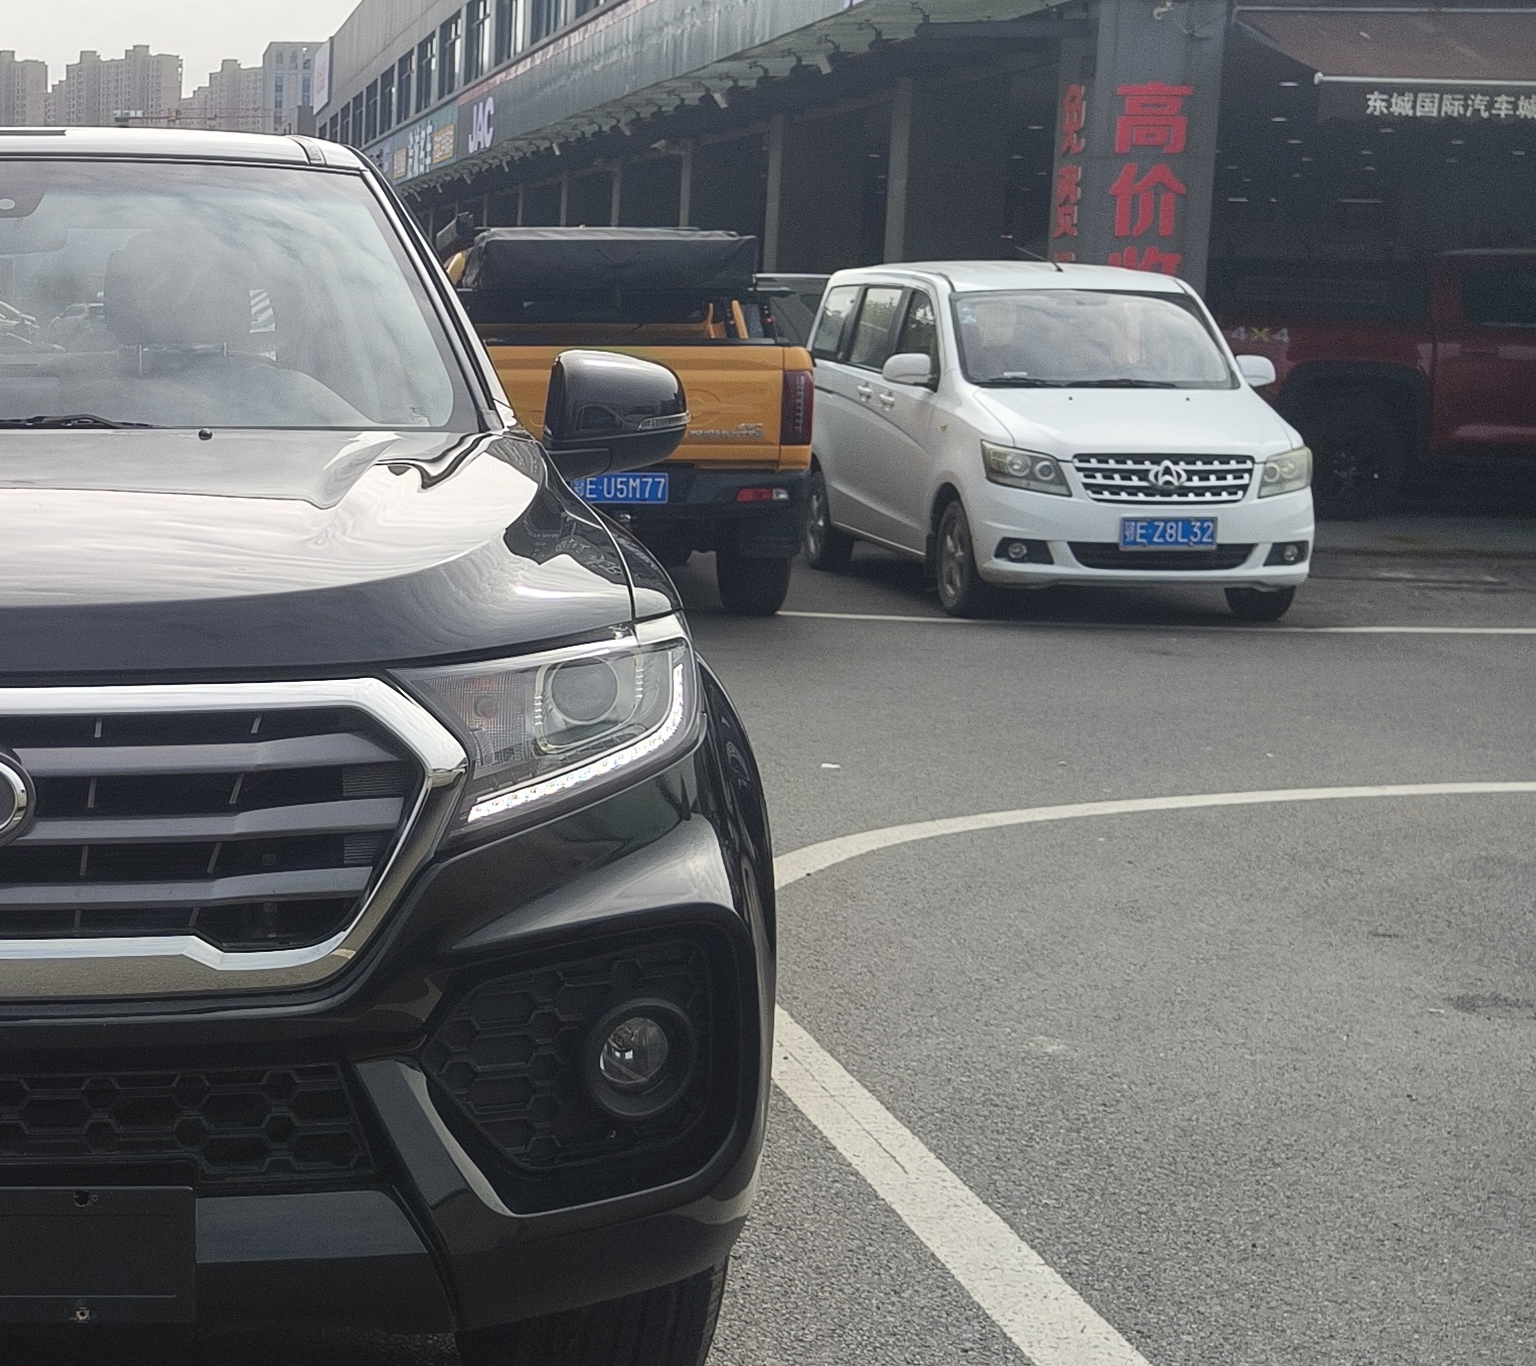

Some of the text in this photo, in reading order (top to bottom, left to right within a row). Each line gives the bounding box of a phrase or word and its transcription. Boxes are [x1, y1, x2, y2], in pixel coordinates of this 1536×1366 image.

[468, 96, 494, 154] JAC
[1366, 91, 1536, 119] 东城国际汽车城
